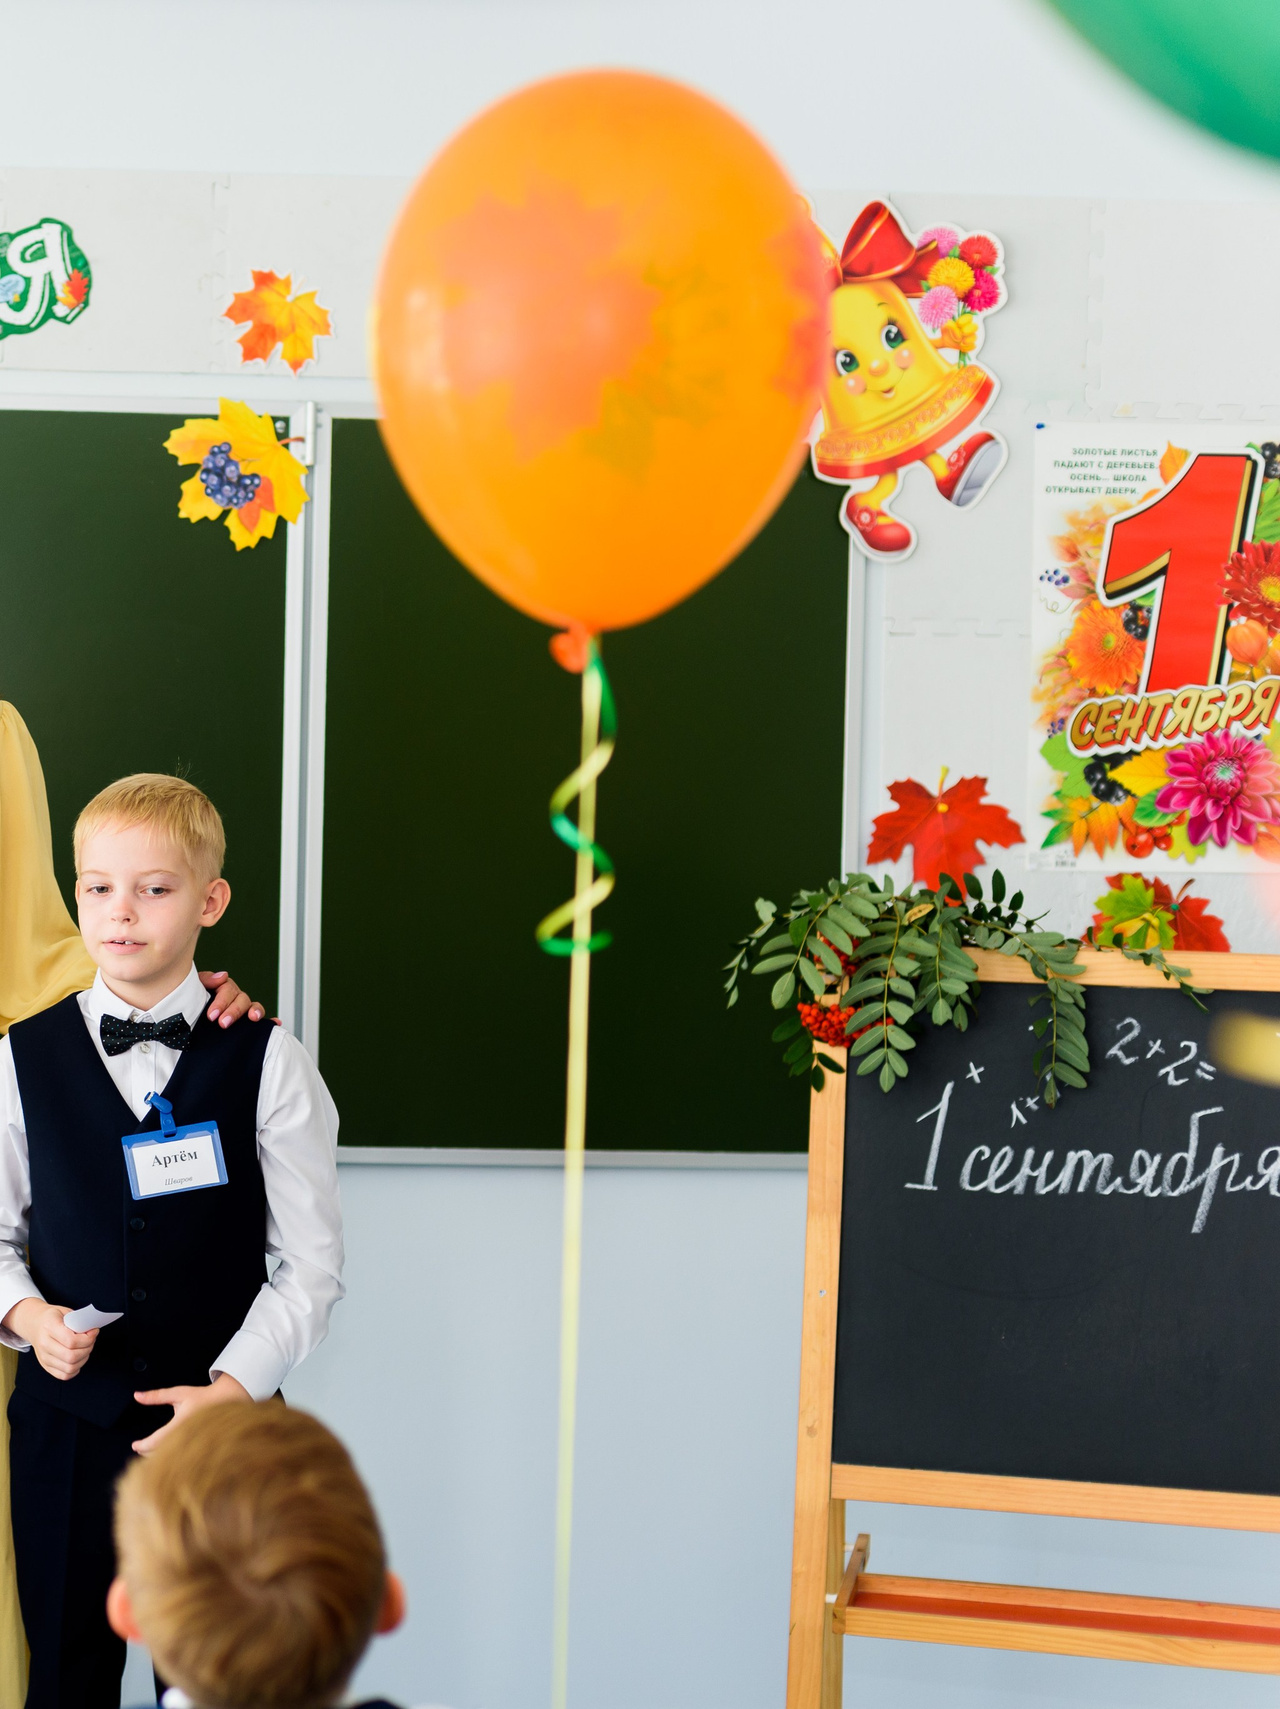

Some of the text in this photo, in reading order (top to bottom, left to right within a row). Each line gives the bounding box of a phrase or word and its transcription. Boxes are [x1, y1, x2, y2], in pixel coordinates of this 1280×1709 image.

[1072, 448, 1158, 457] ЗОЛОТЫЕ ЛИСТЬЯ
[1054, 460, 1094, 470] ПАДАЮТ
[1097, 461, 1104, 469] С
[1113, 474, 1147, 483] ШКОЛА
[1045, 486, 1139, 495] ОТКРЫВАЕТ ДВЕРИ.
[1104, 453, 1260, 690] 1
[1070, 678, 1280, 750] СЕНТЯБРЯ
[152, 1150, 198, 1168] Артём
[904, 1081, 1280, 1234] 1 сентября
